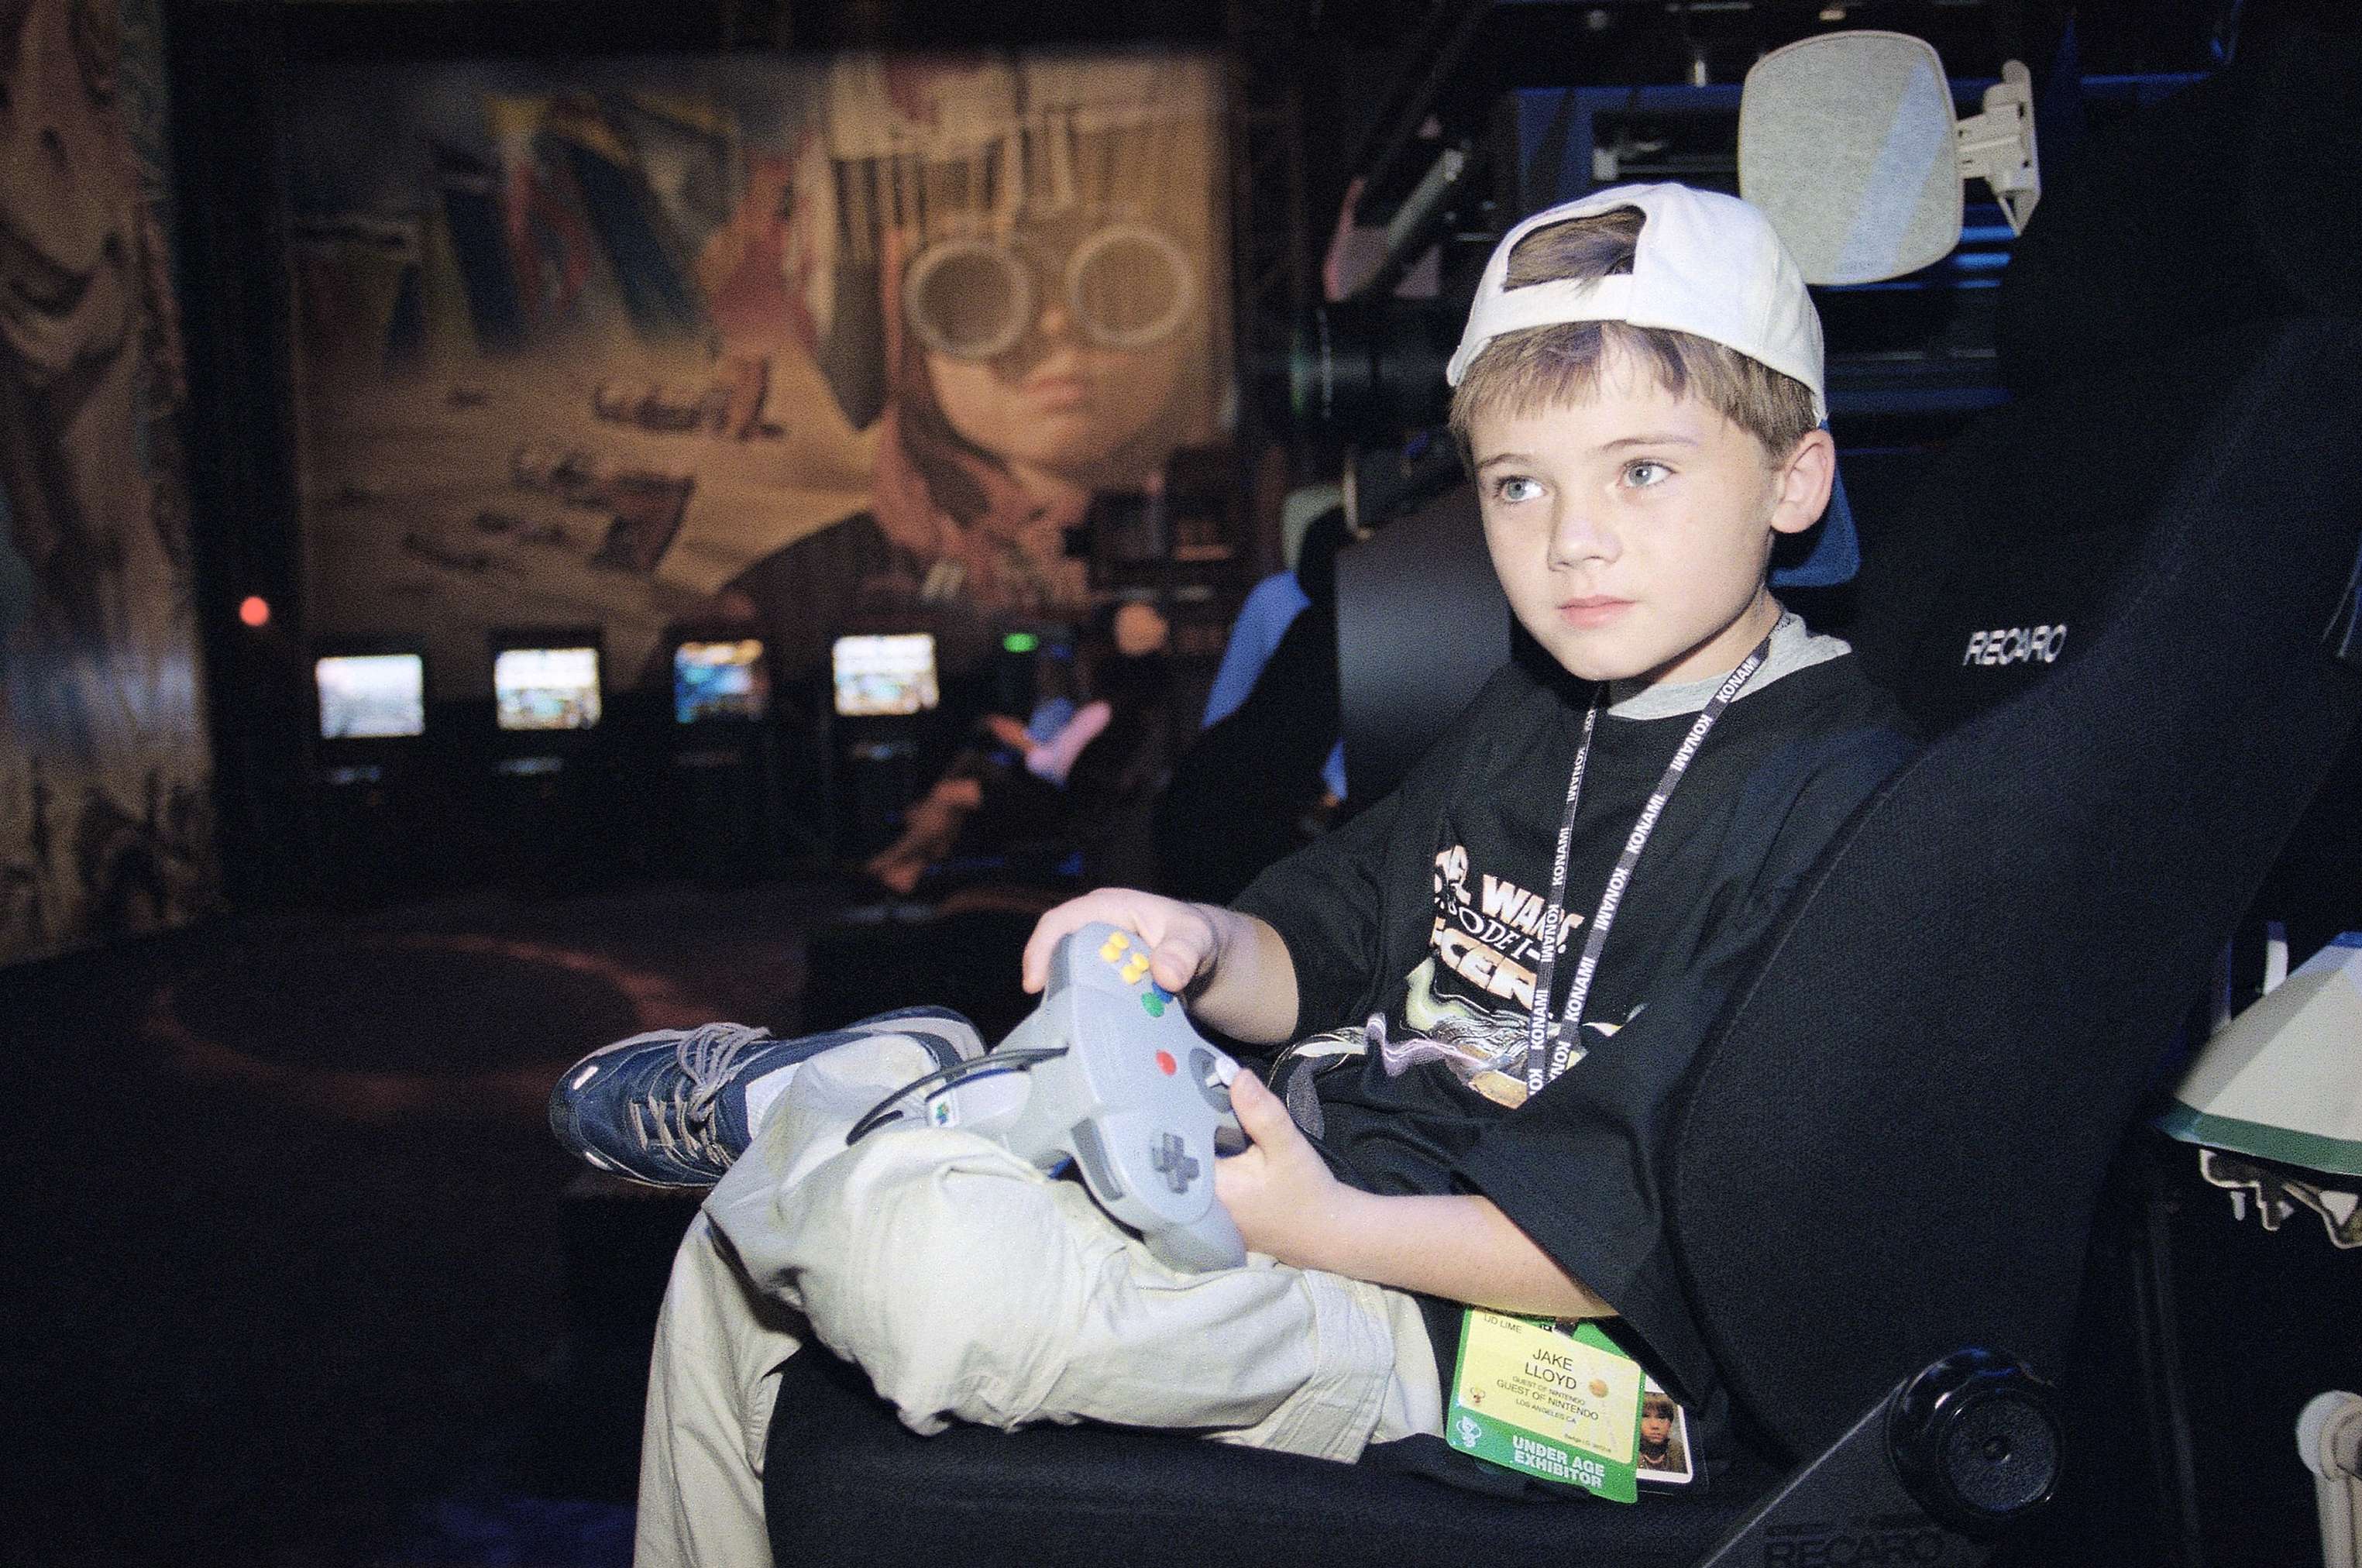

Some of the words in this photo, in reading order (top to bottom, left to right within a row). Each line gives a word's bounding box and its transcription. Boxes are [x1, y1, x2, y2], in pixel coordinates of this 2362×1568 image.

[1962, 624, 2068, 665] RECARO
[1716, 655, 1761, 703] KONAMI
[1670, 714, 1713, 772] KONAMI
[1566, 746, 1586, 805] KONAMI
[1626, 794, 1666, 854] KONAMI
[1552, 827, 1570, 886] KONAMI
[1596, 868, 1629, 930] KONAMI
[1541, 904, 1560, 962] KONAMI
[1565, 958, 1596, 1023] KONAMI
[1530, 990, 1549, 1050] KONAMI
[1500, 1320, 1523, 1334] LIME
[1512, 1376, 1536, 1387] GUEST
[1525, 1362, 1577, 1390] LLOYD
[1532, 1349, 1573, 1372] JAKE
[1496, 1379, 1530, 1396] GUEST
[1532, 1391, 1545, 1401] OF
[1548, 1397, 1599, 1421] NINTENDO
[1516, 1398, 1530, 1408] LOS
[1512, 1435, 1569, 1465] UNDER
[1572, 1456, 1605, 1477] AGE
[1514, 1449, 1604, 1489] EXHIBITOR
